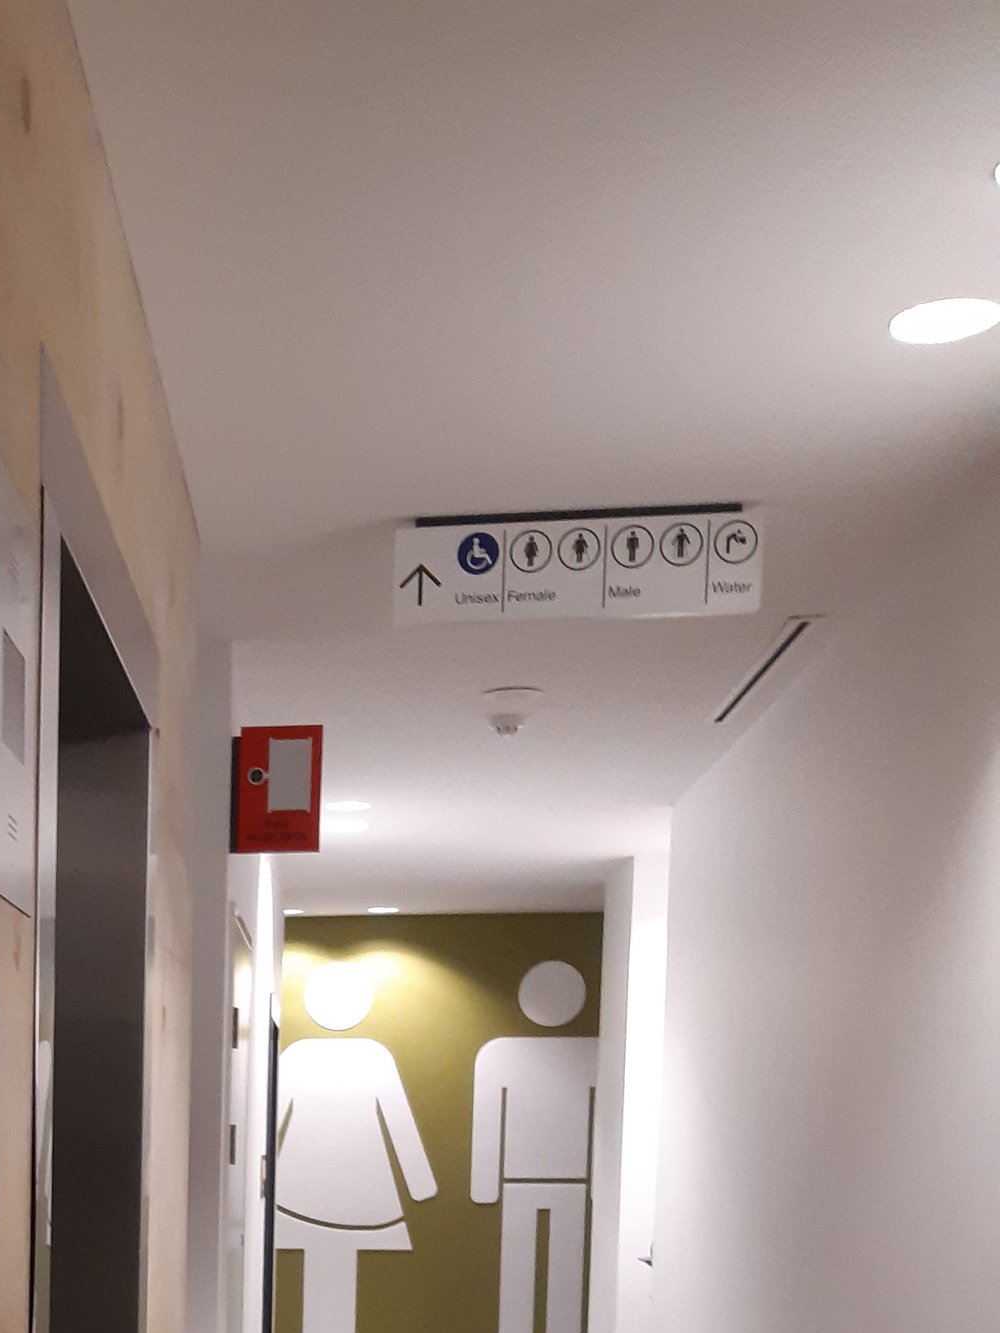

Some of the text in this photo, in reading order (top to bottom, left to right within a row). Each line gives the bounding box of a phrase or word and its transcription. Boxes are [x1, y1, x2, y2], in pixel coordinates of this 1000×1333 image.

[454, 580, 753, 605] Unisex Female Male Water
